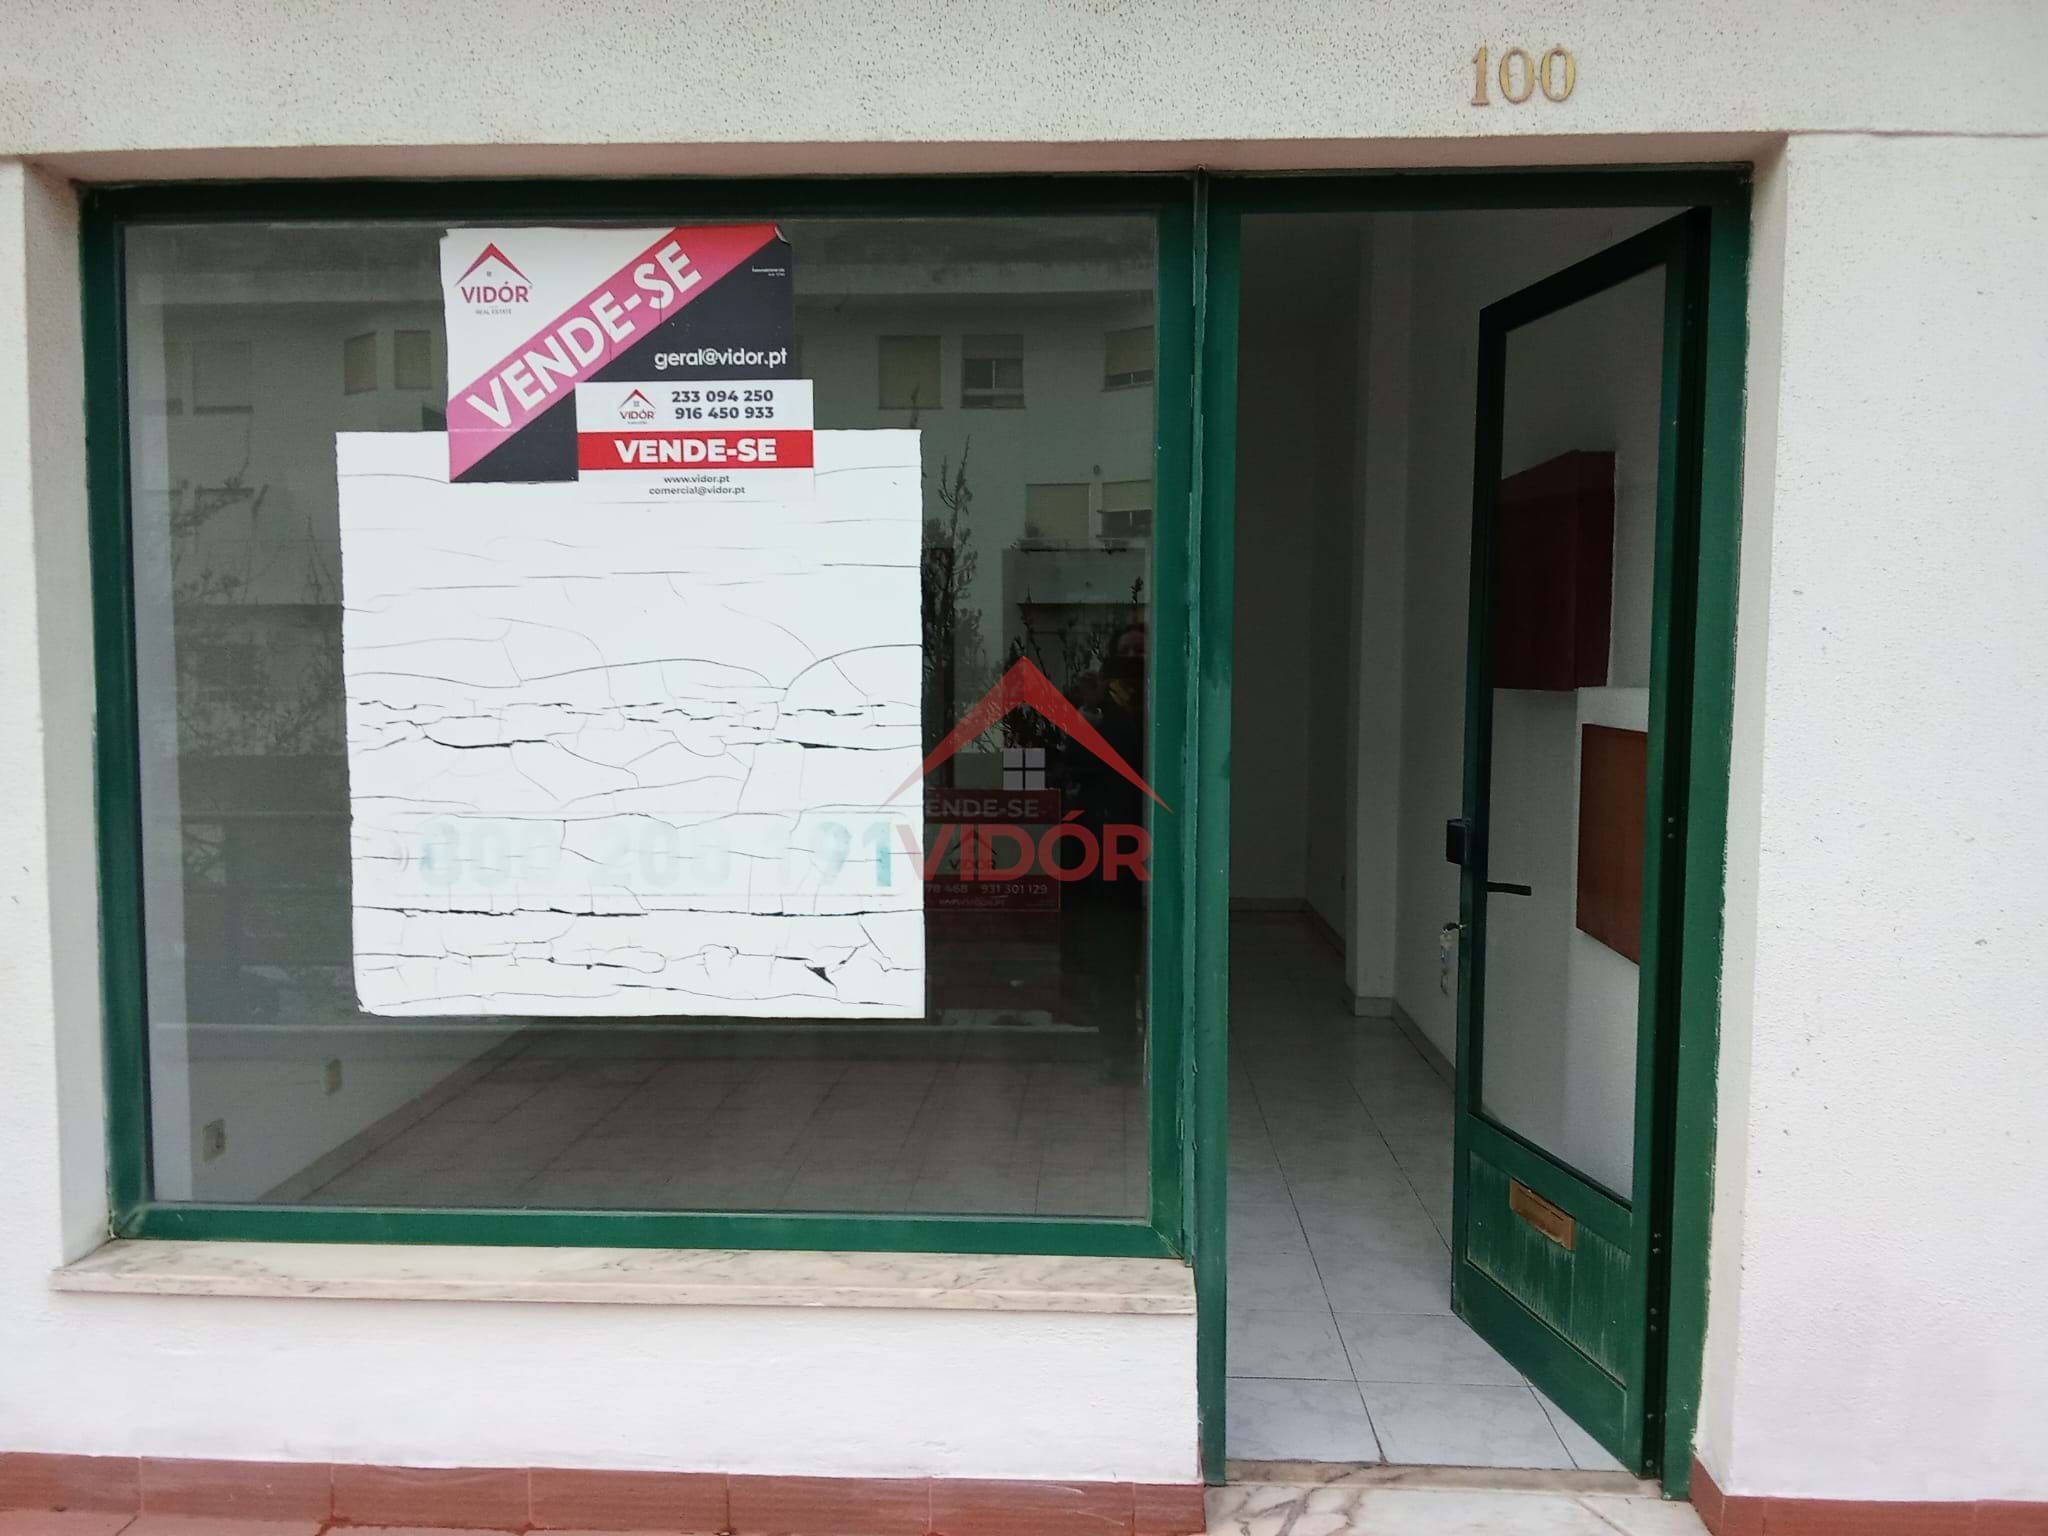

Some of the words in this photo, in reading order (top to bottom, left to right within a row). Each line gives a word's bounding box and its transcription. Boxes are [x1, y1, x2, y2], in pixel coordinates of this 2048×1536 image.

[1471, 46, 1577, 106] 100
[461, 281, 529, 304] VIDÓR
[465, 240, 702, 429] VENDE-SE
[654, 348, 788, 370] geral@vidor.pt
[671, 390, 700, 403] 233
[706, 390, 739, 403] 094
[743, 389, 774, 402] 250
[619, 408, 655, 420] VIDÓR
[675, 406, 702, 420] 916
[708, 406, 739, 420] 450
[745, 405, 774, 419] 933
[614, 438, 777, 464] VENDE-SE
[663, 475, 730, 484] www.vidor.pt
[648, 485, 746, 496] comercial@vidor.pt
[925, 799, 1040, 818] ENDE-SE
